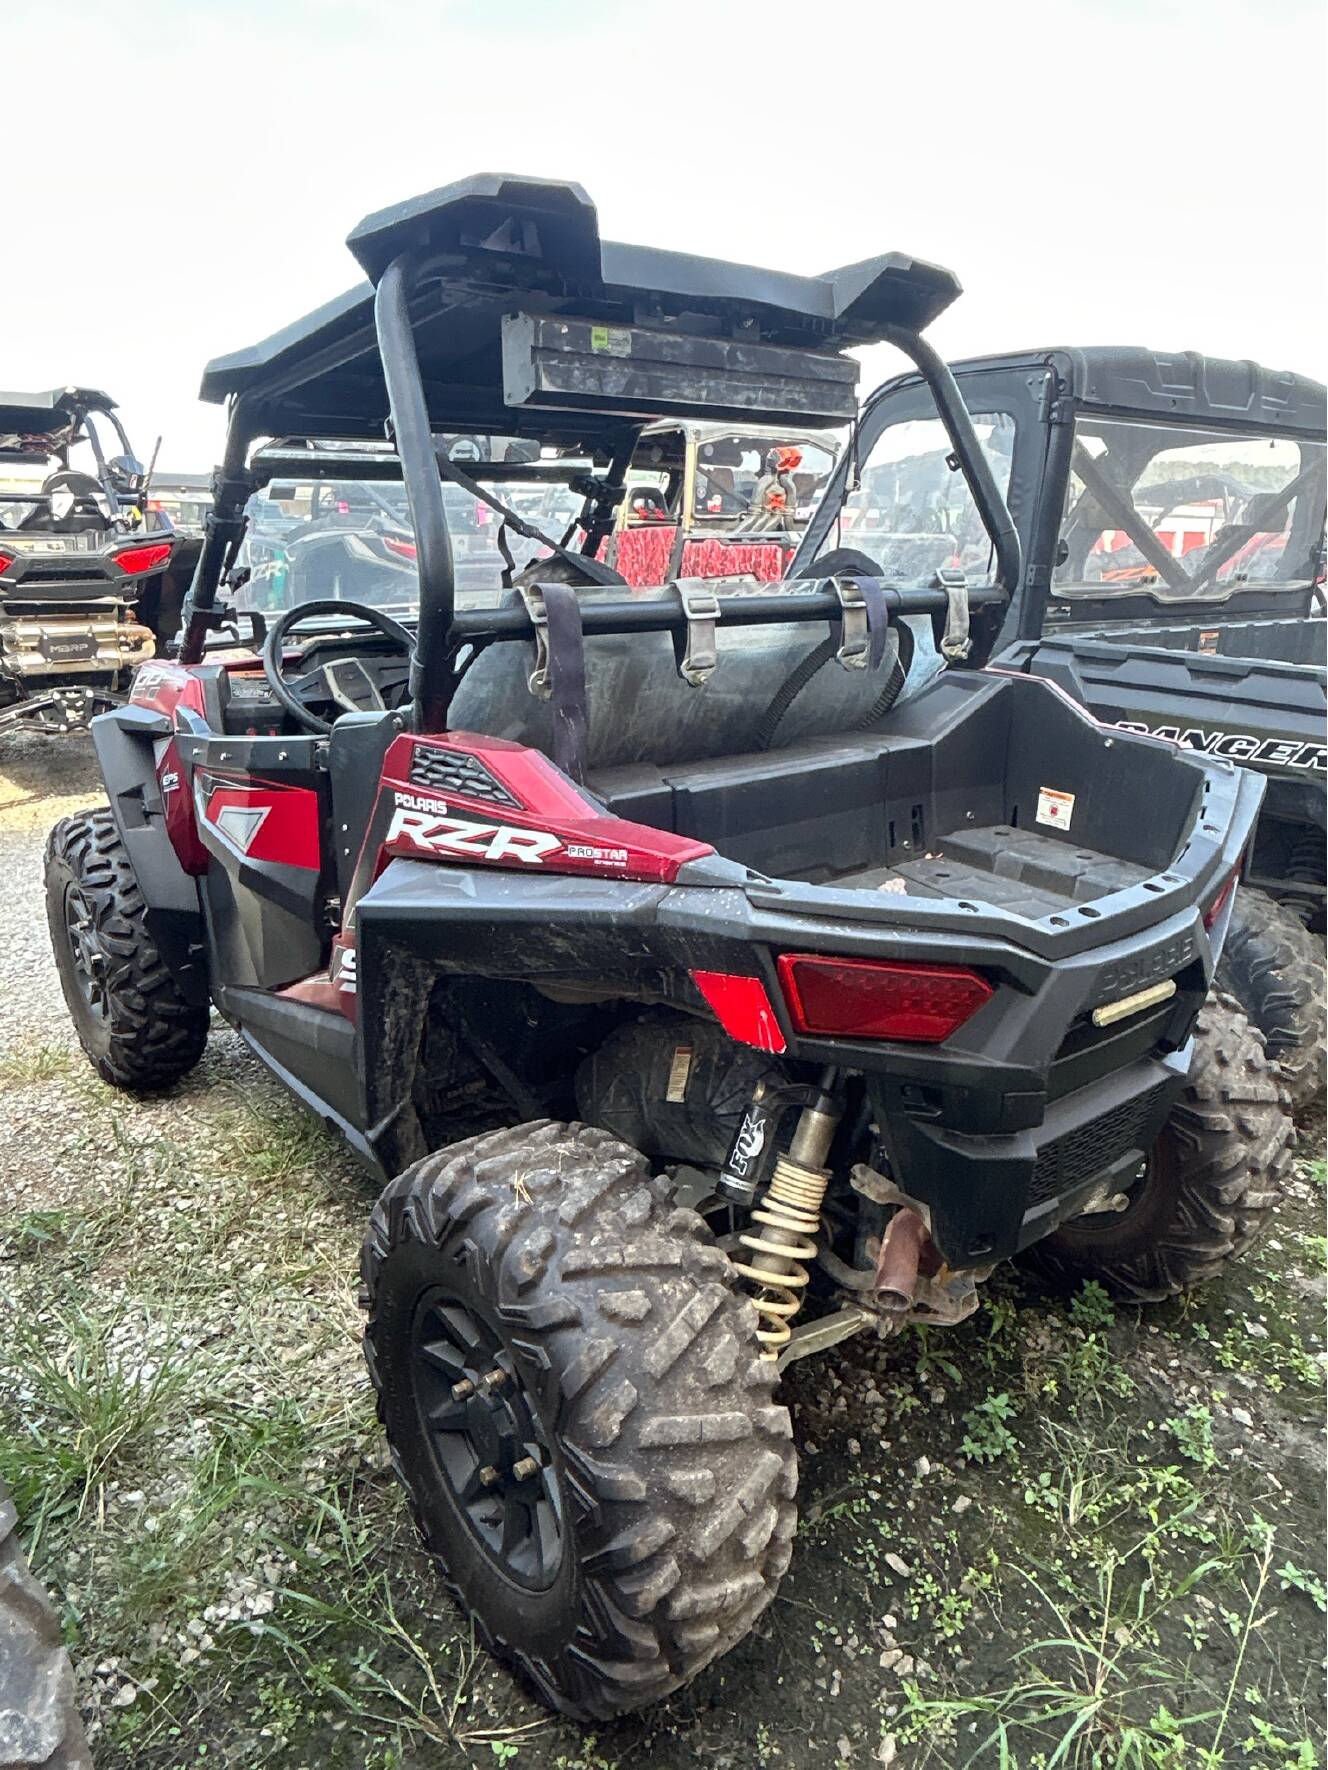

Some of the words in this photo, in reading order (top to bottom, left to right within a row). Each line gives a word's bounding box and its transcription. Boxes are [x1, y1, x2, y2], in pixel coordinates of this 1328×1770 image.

[50, 643, 89, 653] MBRP
[394, 792, 448, 815] POLARIS
[385, 808, 563, 863] RZR
[567, 845, 628, 861] PROSTAR
[729, 1112, 766, 1176] FOX
